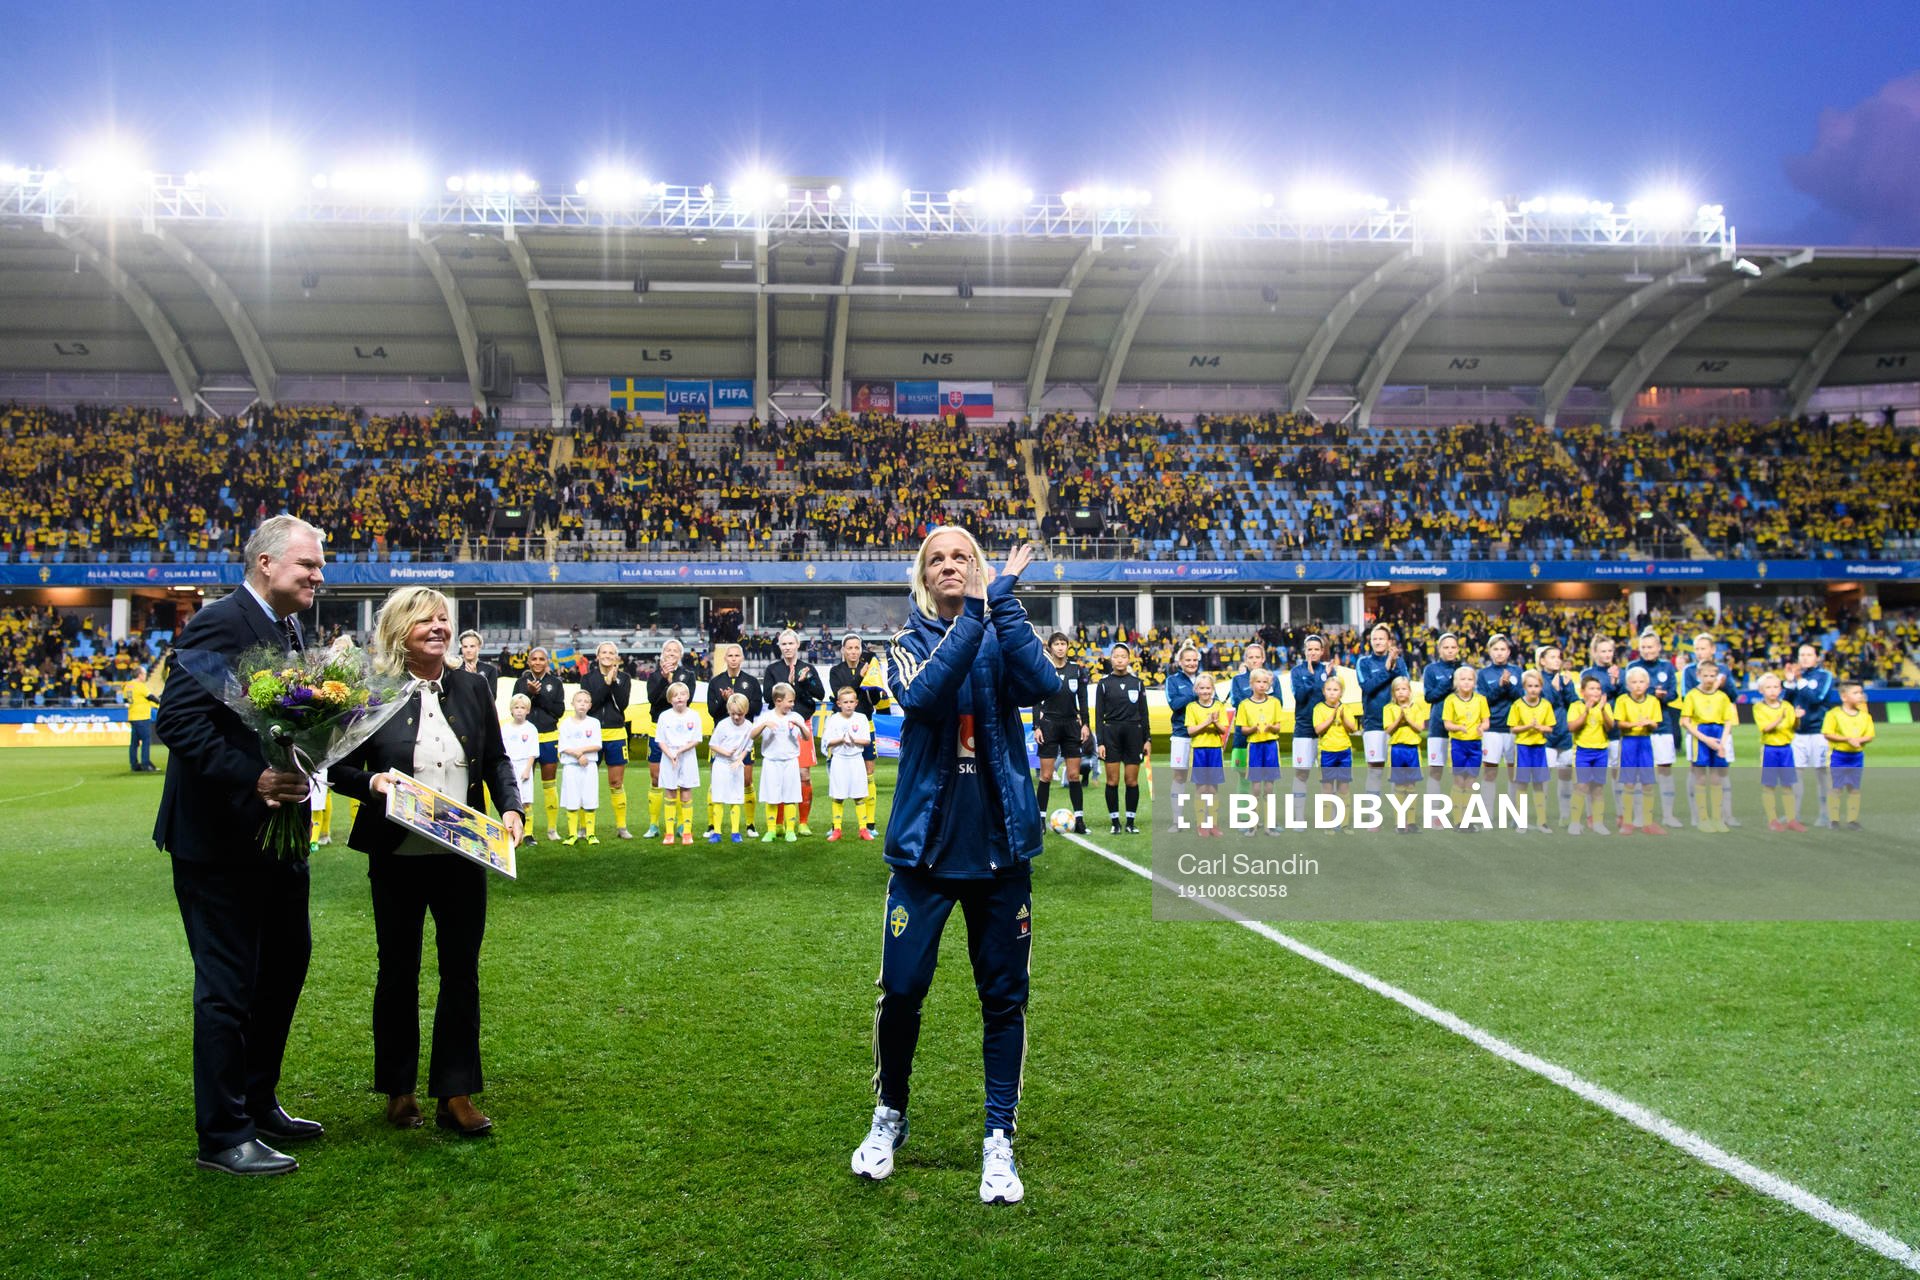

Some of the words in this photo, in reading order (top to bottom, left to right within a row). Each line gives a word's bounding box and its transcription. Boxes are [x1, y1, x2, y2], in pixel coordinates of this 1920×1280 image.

[54, 342, 90, 356] L3
[354, 346, 388, 360] L4
[642, 349, 673, 362] L5
[922, 352, 953, 365] N5
[1189, 355, 1220, 368] N4
[1449, 358, 1480, 370] N3
[1696, 360, 1729, 372] N2
[1877, 356, 1907, 368] N1
[669, 391, 706, 403] UEFA
[718, 388, 749, 399] FIFA
